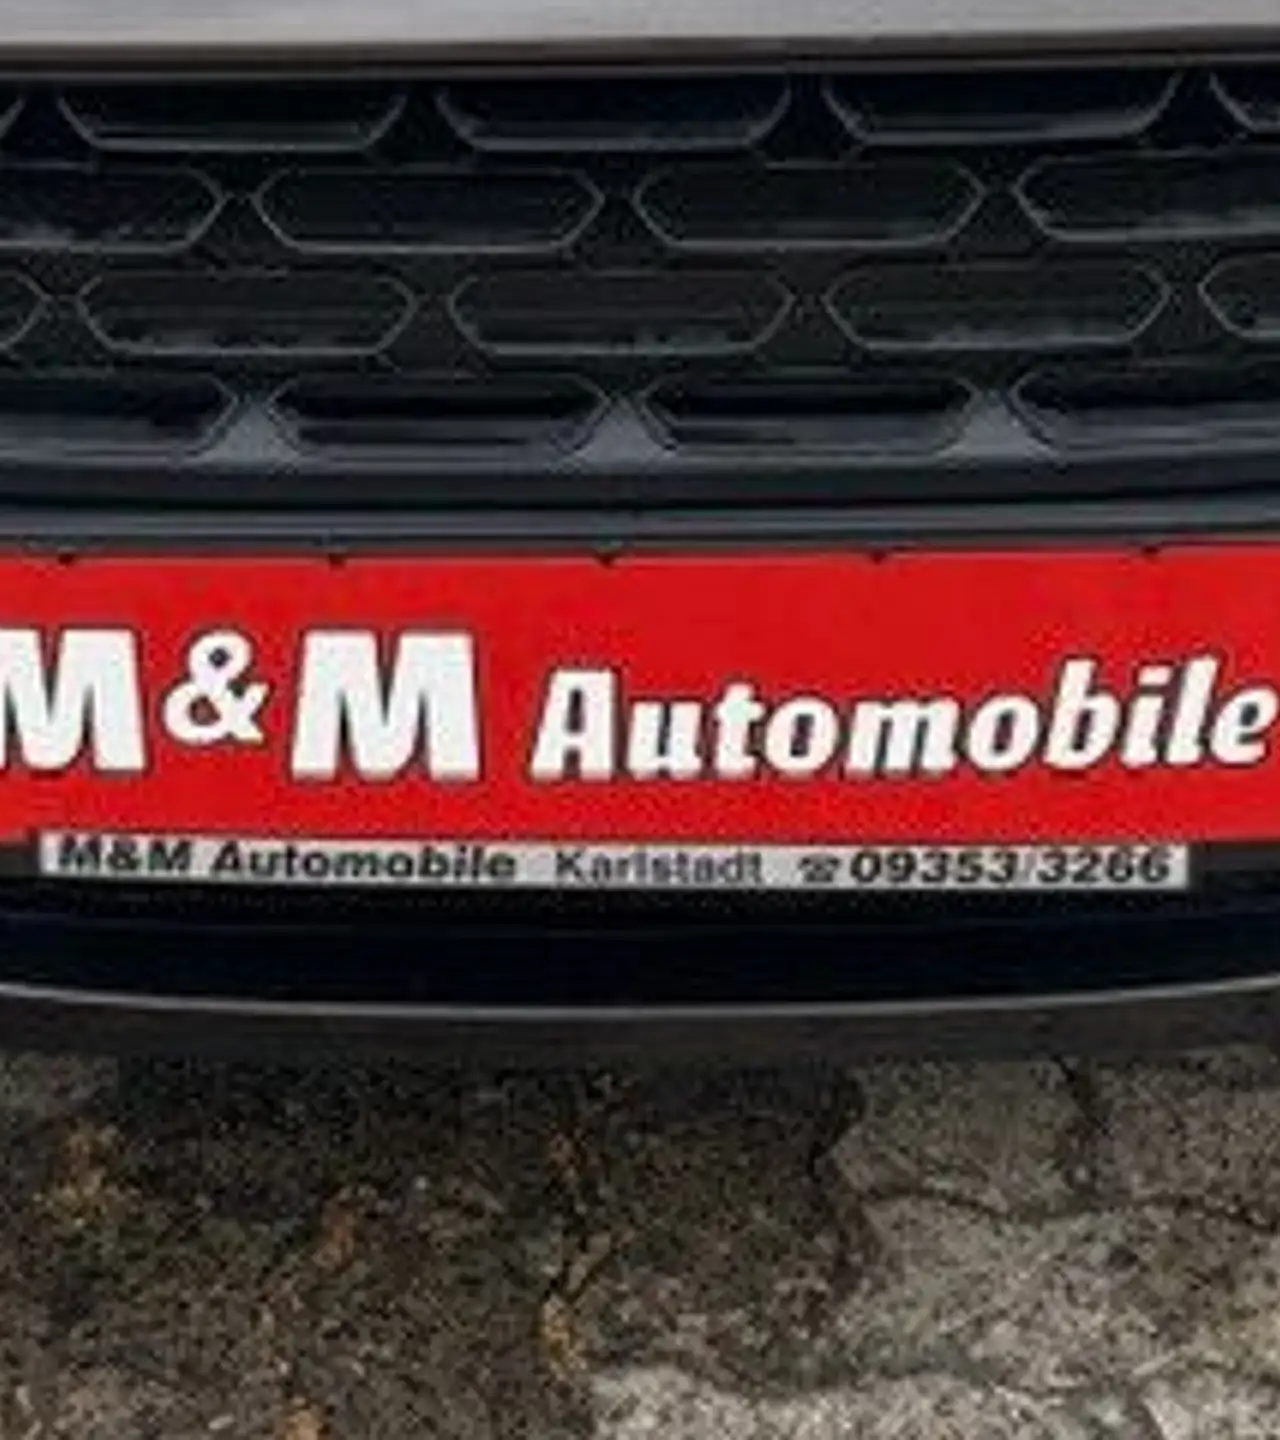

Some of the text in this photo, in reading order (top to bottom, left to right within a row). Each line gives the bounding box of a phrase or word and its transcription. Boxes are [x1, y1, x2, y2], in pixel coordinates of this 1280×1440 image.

[528, 657, 1280, 780] Automobile
[57, 836, 1173, 885] M&M Automobile Karlstadt 09353/3266
